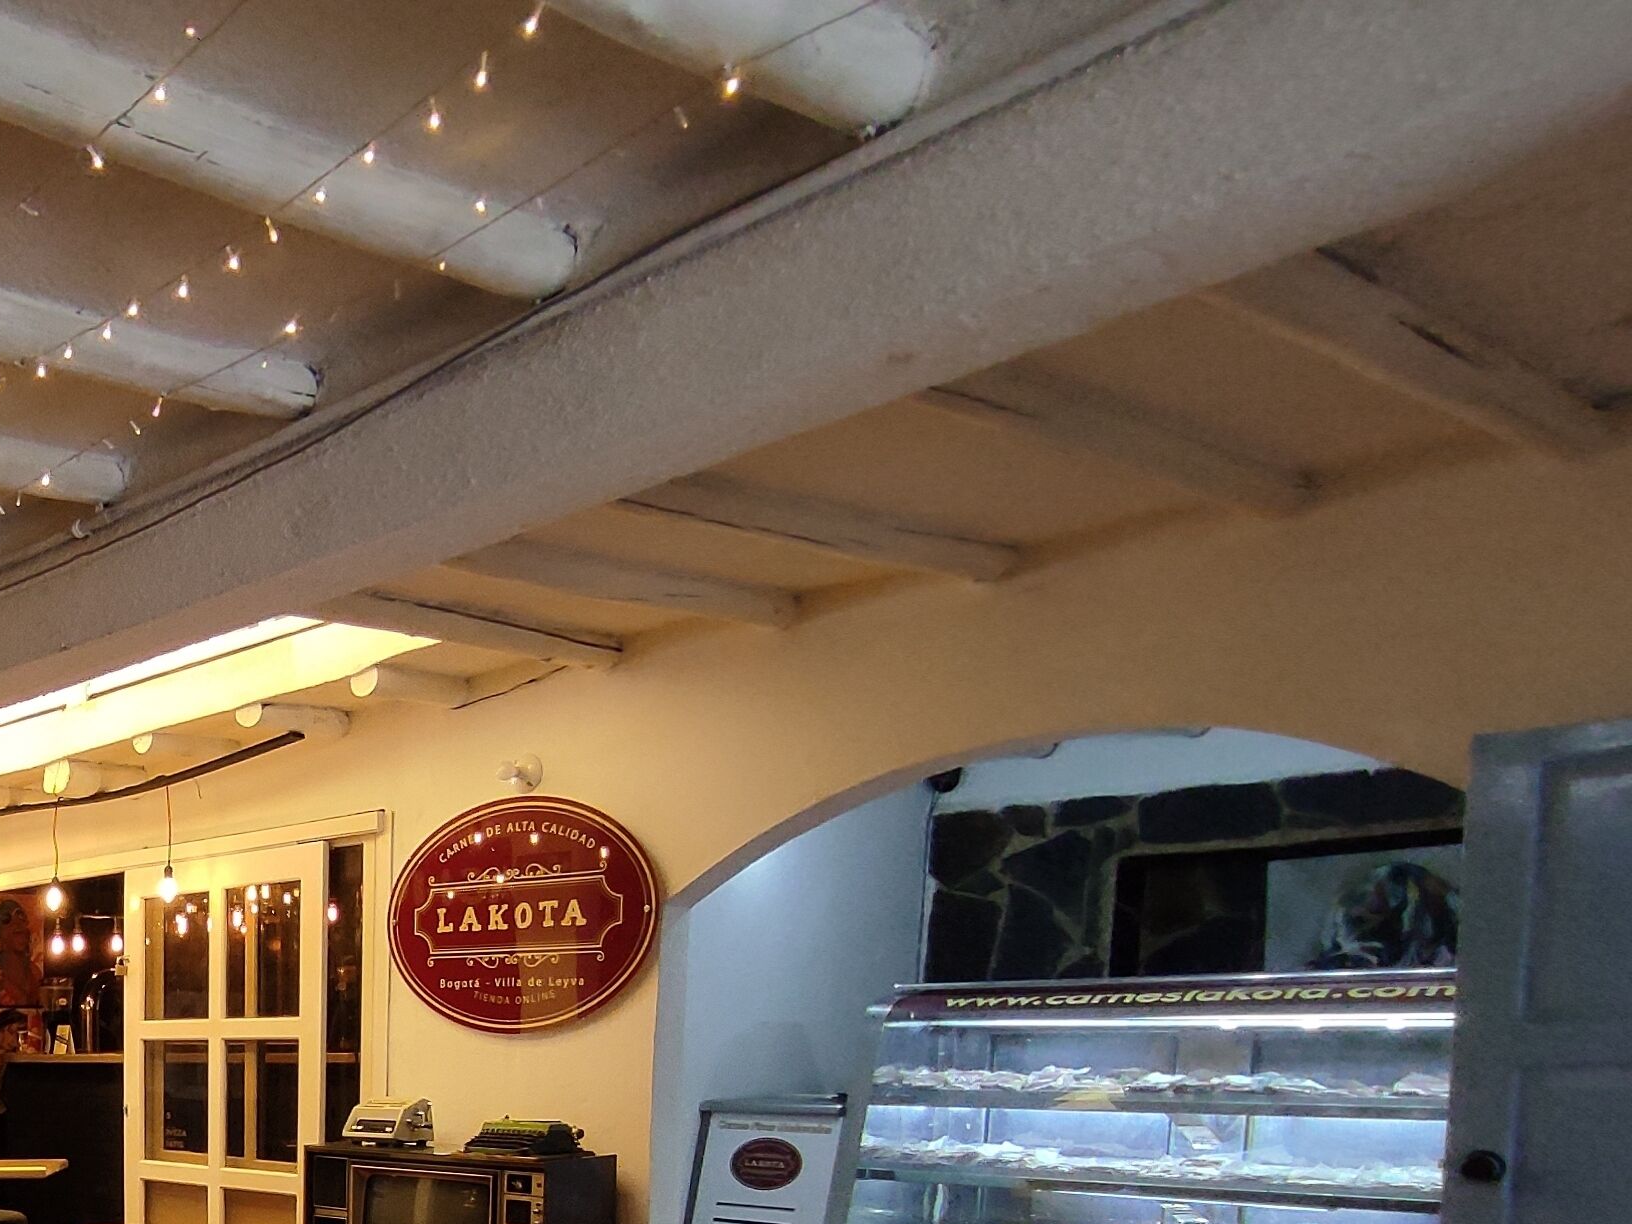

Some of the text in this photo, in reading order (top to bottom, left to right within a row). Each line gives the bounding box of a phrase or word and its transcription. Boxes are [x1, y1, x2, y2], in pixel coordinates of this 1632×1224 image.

[486, 824, 501, 838] DE
[506, 820, 536, 833] ALTA
[541, 821, 596, 849] CALIDAD
[436, 899, 587, 933] LAKOTA
[439, 978, 480, 990] Bogotá
[494, 977, 522, 987] Villa
[527, 976, 542, 987] de
[548, 976, 585, 989] Leyva
[473, 989, 556, 1005] TIENDA ONLINE
[946, 985, 1457, 1008] www.carneslakota.com
